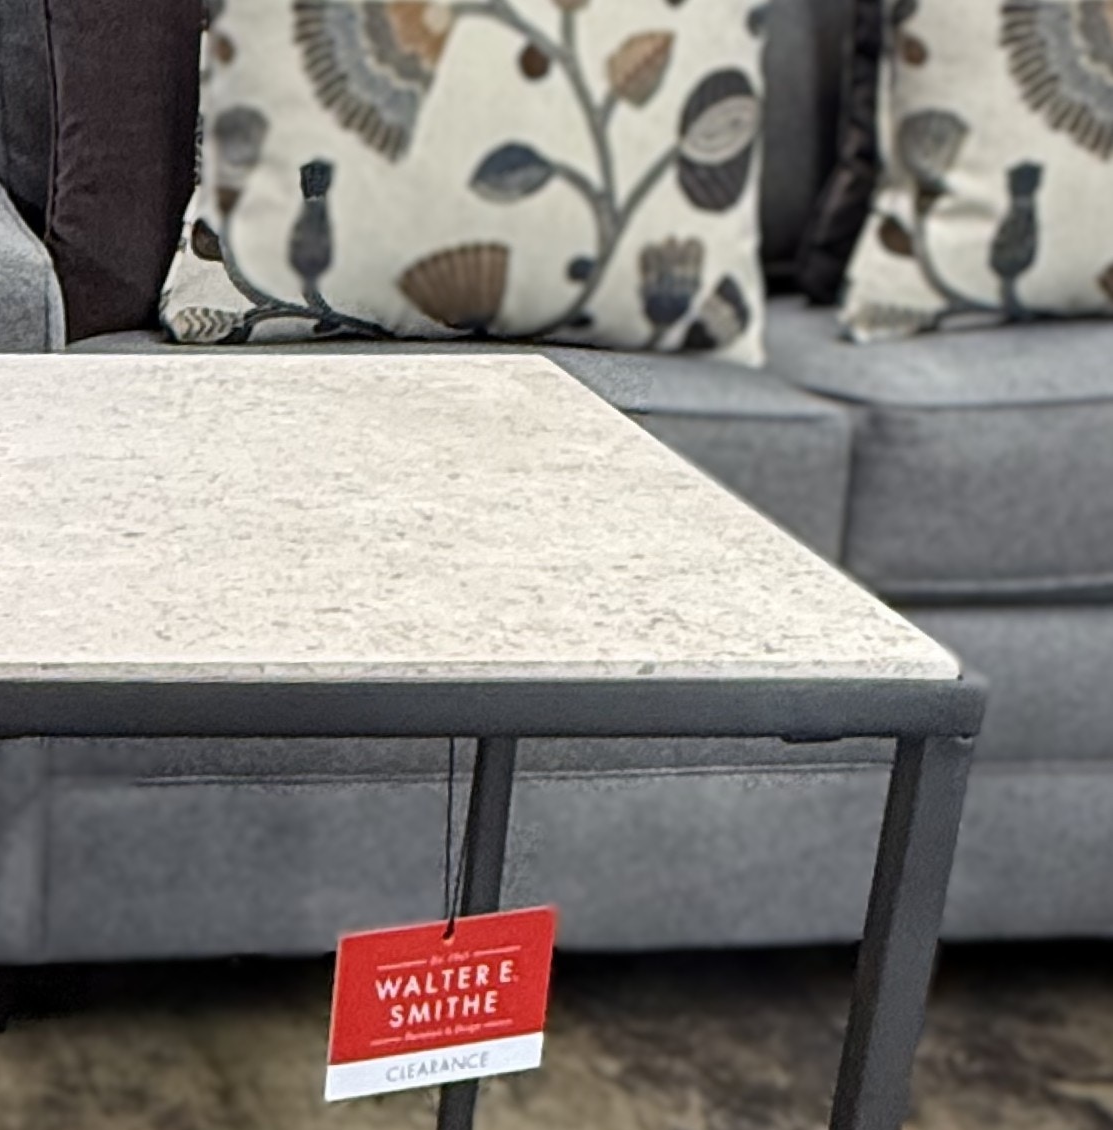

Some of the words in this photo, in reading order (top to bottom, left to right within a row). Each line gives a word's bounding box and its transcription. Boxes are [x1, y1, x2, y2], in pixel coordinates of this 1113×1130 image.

[375, 964, 490, 1001] WALTER
[389, 990, 497, 1028] SMITHE
[386, 1051, 490, 1082] CLEARANCE
